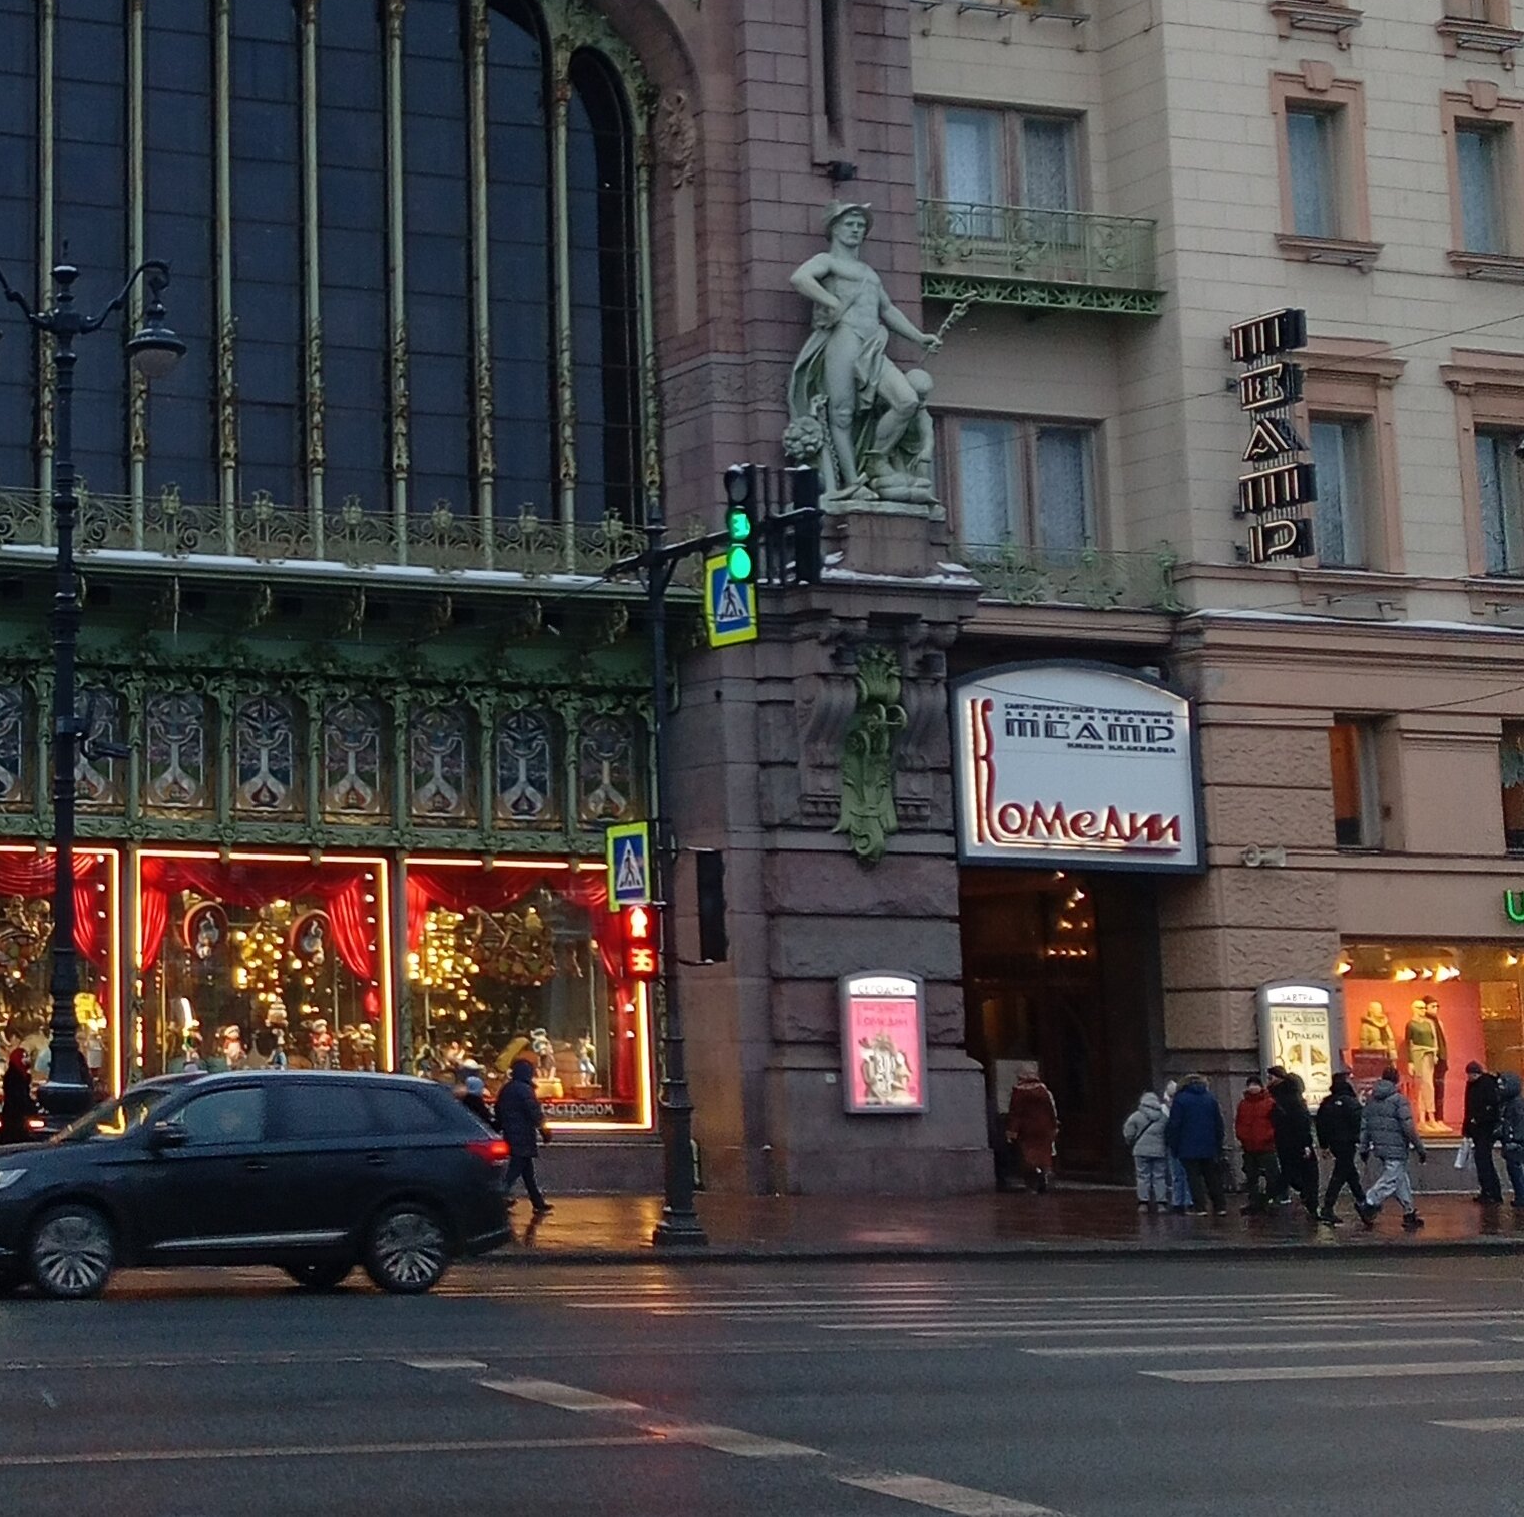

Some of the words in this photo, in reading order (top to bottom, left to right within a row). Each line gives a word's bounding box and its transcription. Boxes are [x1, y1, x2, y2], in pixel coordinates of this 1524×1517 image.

[1229, 308, 1316, 564] ТЕАТР
[1005, 711, 1175, 725] АКАДЕМИЧЕСКИЙ
[1005, 718, 1175, 743] ТЕАТР
[1280, 993, 1315, 1001] ЗАВТРА
